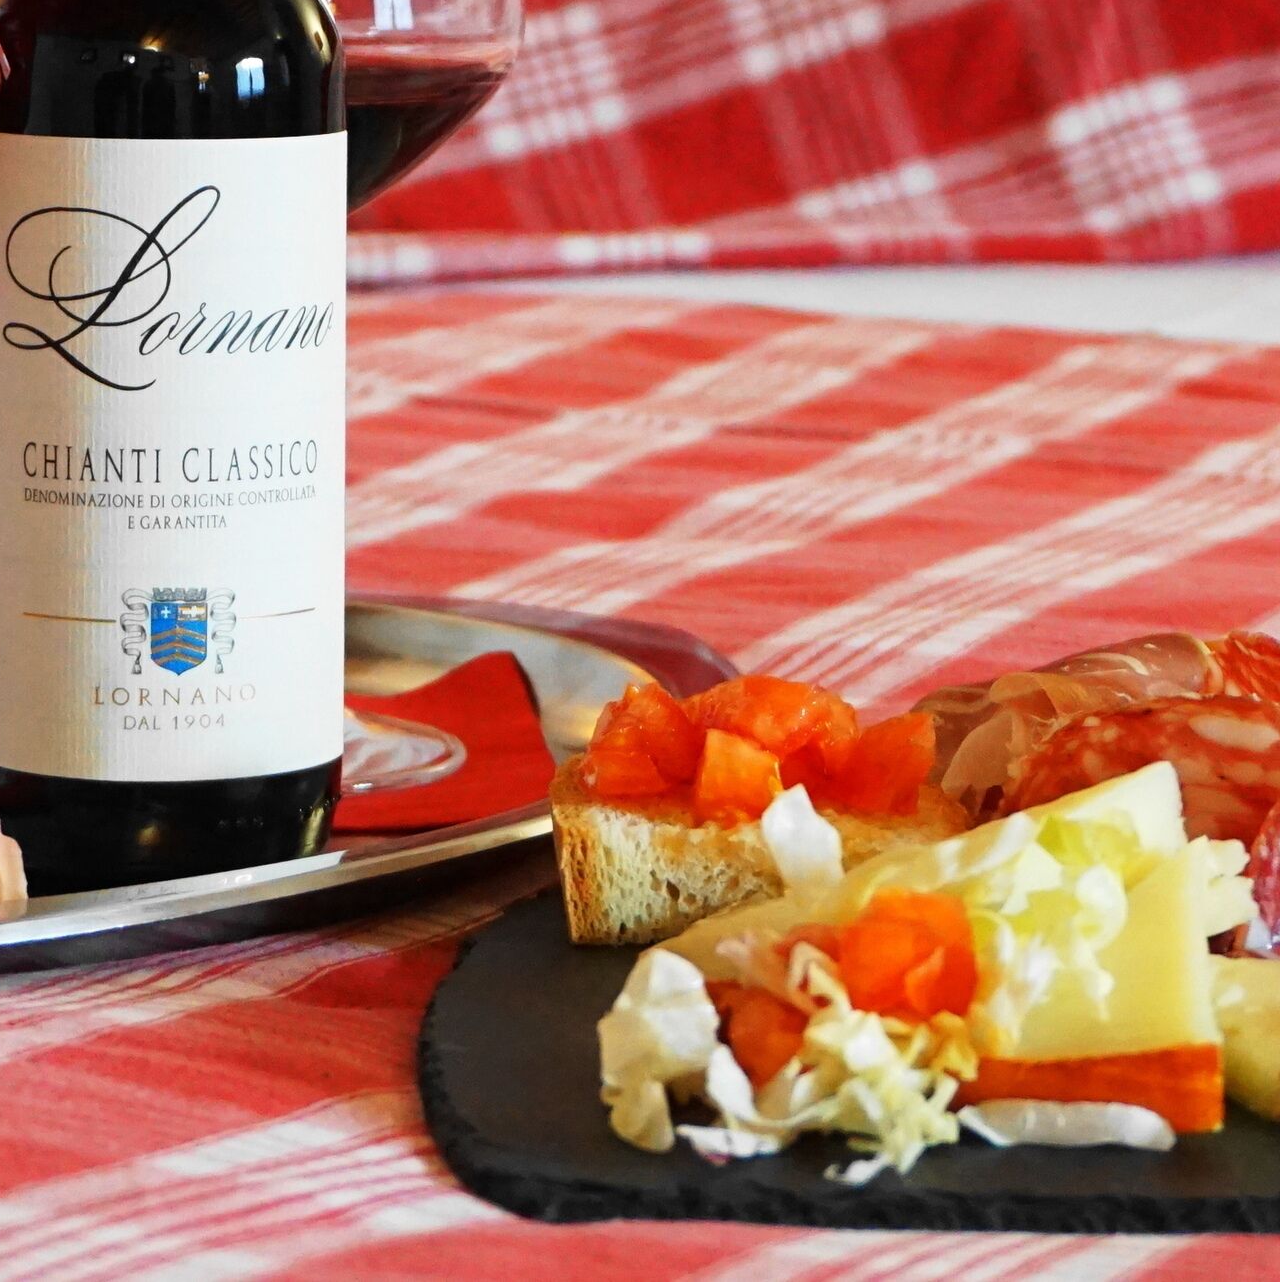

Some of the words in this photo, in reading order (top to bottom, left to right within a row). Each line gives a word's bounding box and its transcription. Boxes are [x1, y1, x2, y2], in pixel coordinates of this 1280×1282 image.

[2, 184, 335, 392] Lornano
[22, 441, 162, 484] CHIANTI
[181, 439, 318, 484] CLASSICO
[23, 487, 144, 509] DENOMINAZIONE
[150, 493, 166, 509] DI
[170, 491, 234, 509] ORIGINE
[238, 484, 317, 507] CONTROLLATA
[127, 515, 136, 530] E
[139, 514, 228, 530] GARANTITA
[94, 683, 257, 707] LORNANO
[122, 715, 161, 731] DAL
[171, 713, 226, 731] 1904
